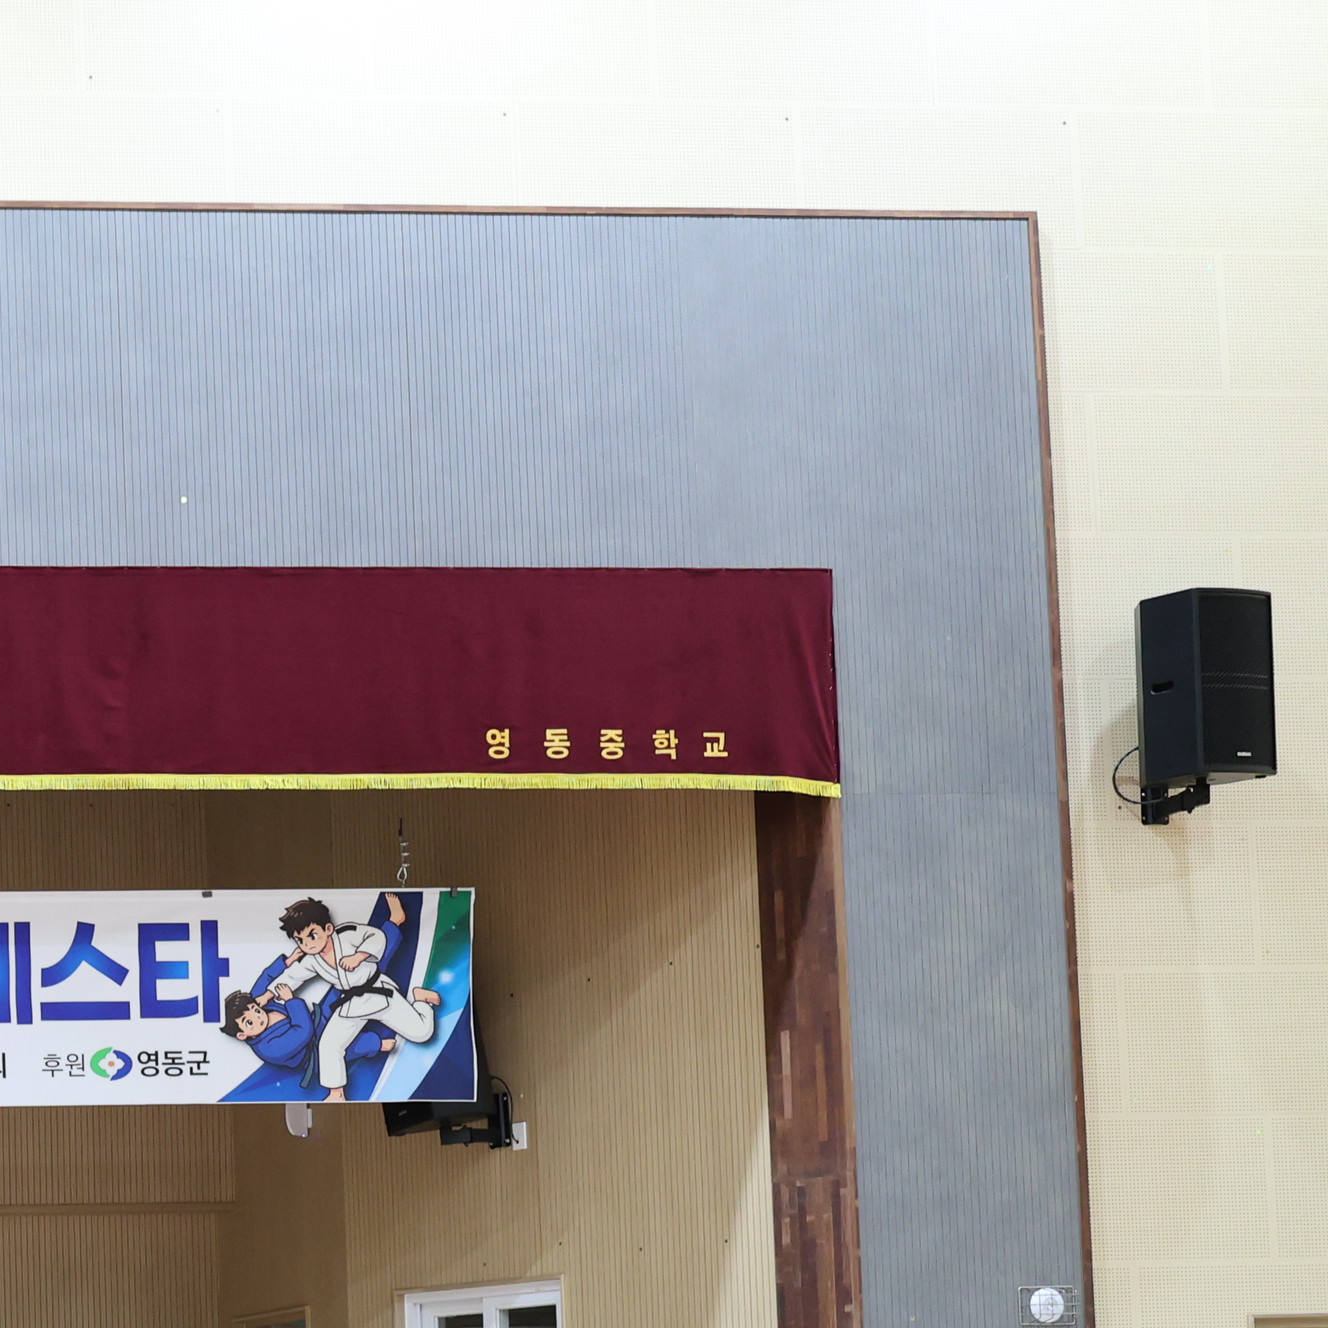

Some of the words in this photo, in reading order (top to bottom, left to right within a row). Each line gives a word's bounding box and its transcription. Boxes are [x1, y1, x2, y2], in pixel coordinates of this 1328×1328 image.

[485, 728, 729, 760] 영동중학교
[43, 1054, 84, 1077] 후원
[138, 1051, 209, 1077] 영동군
